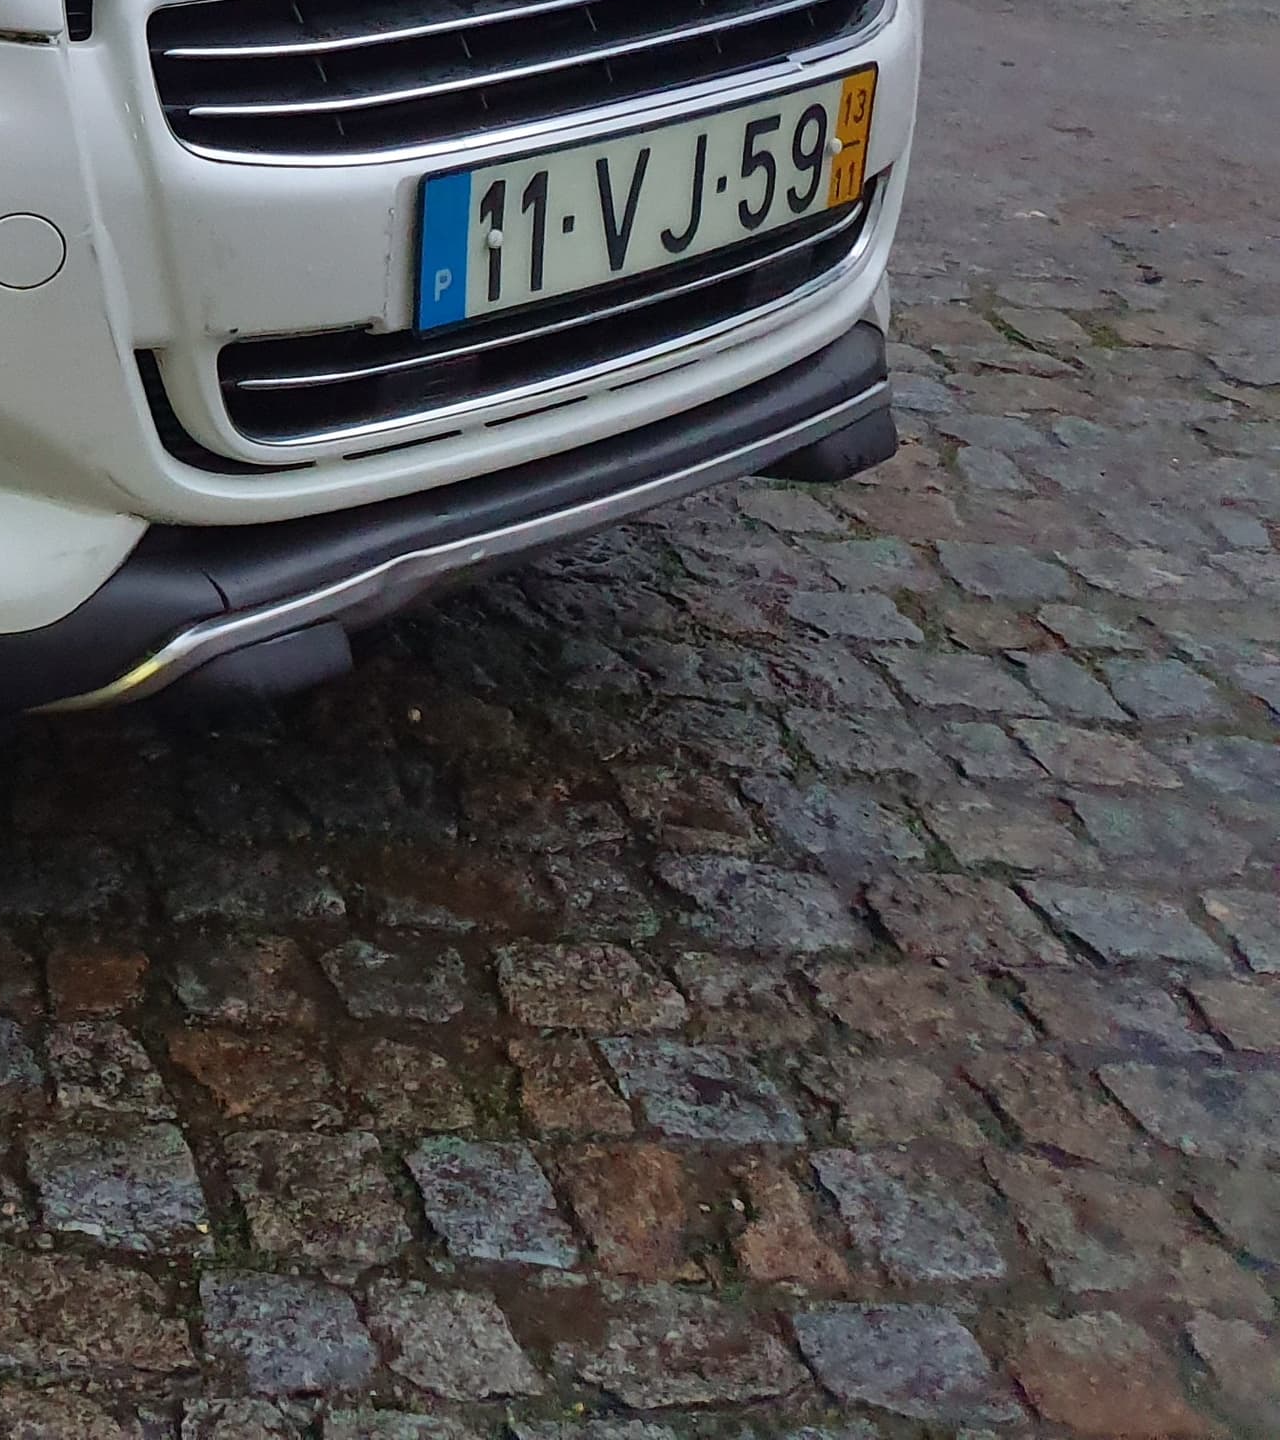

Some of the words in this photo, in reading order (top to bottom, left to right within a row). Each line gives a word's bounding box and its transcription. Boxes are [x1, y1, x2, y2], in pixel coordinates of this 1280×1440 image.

[844, 88, 867, 127] 13
[835, 161, 856, 199] 11
[434, 268, 453, 302] P
